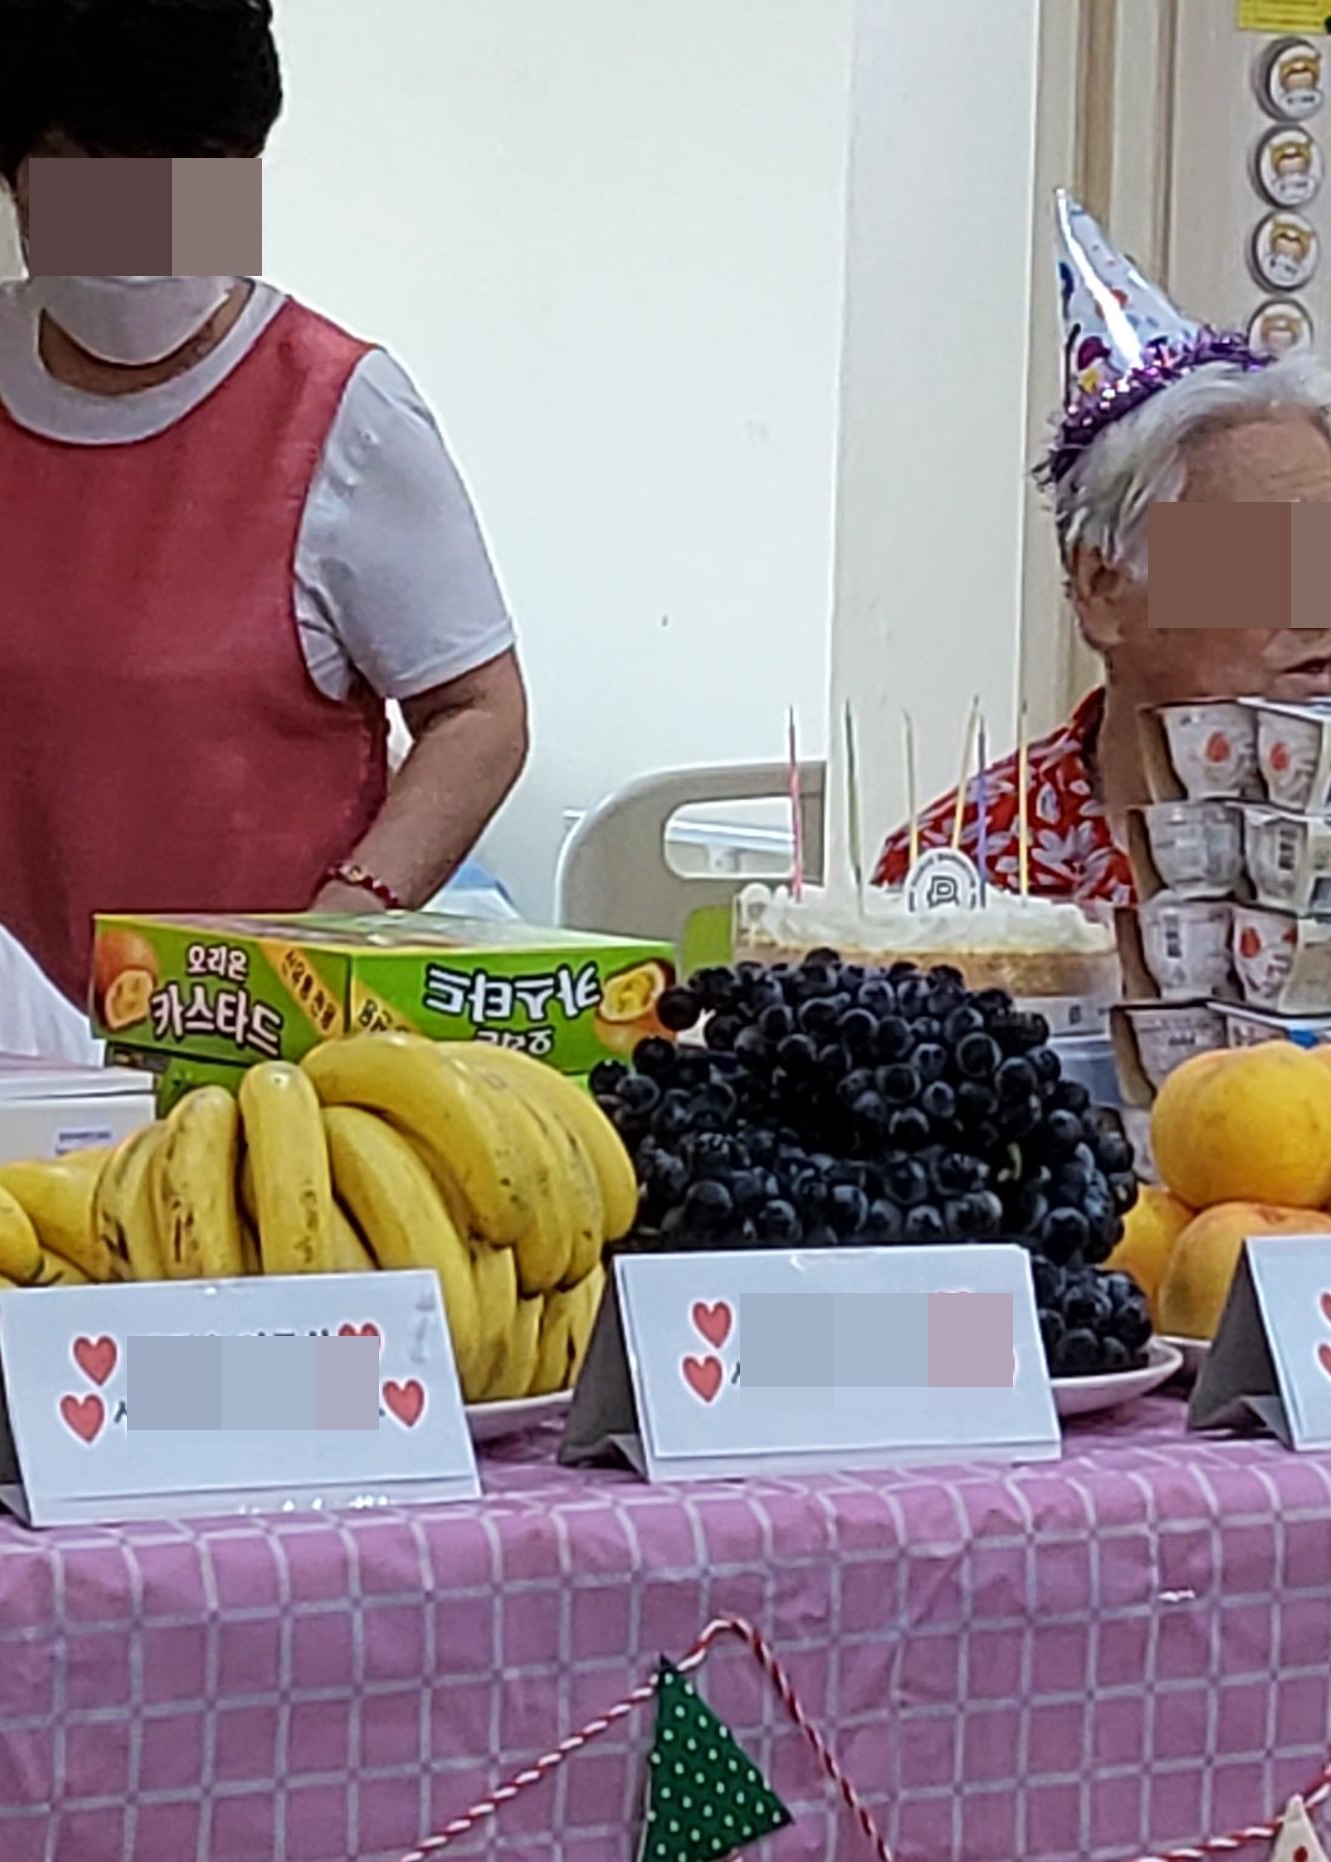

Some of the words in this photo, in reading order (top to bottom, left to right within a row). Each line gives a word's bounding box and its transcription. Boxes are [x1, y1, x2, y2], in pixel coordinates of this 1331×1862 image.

[188, 945, 249, 982] 오리온
[150, 983, 282, 1057] 카스타드
[426, 965, 601, 1025] 카스타드
